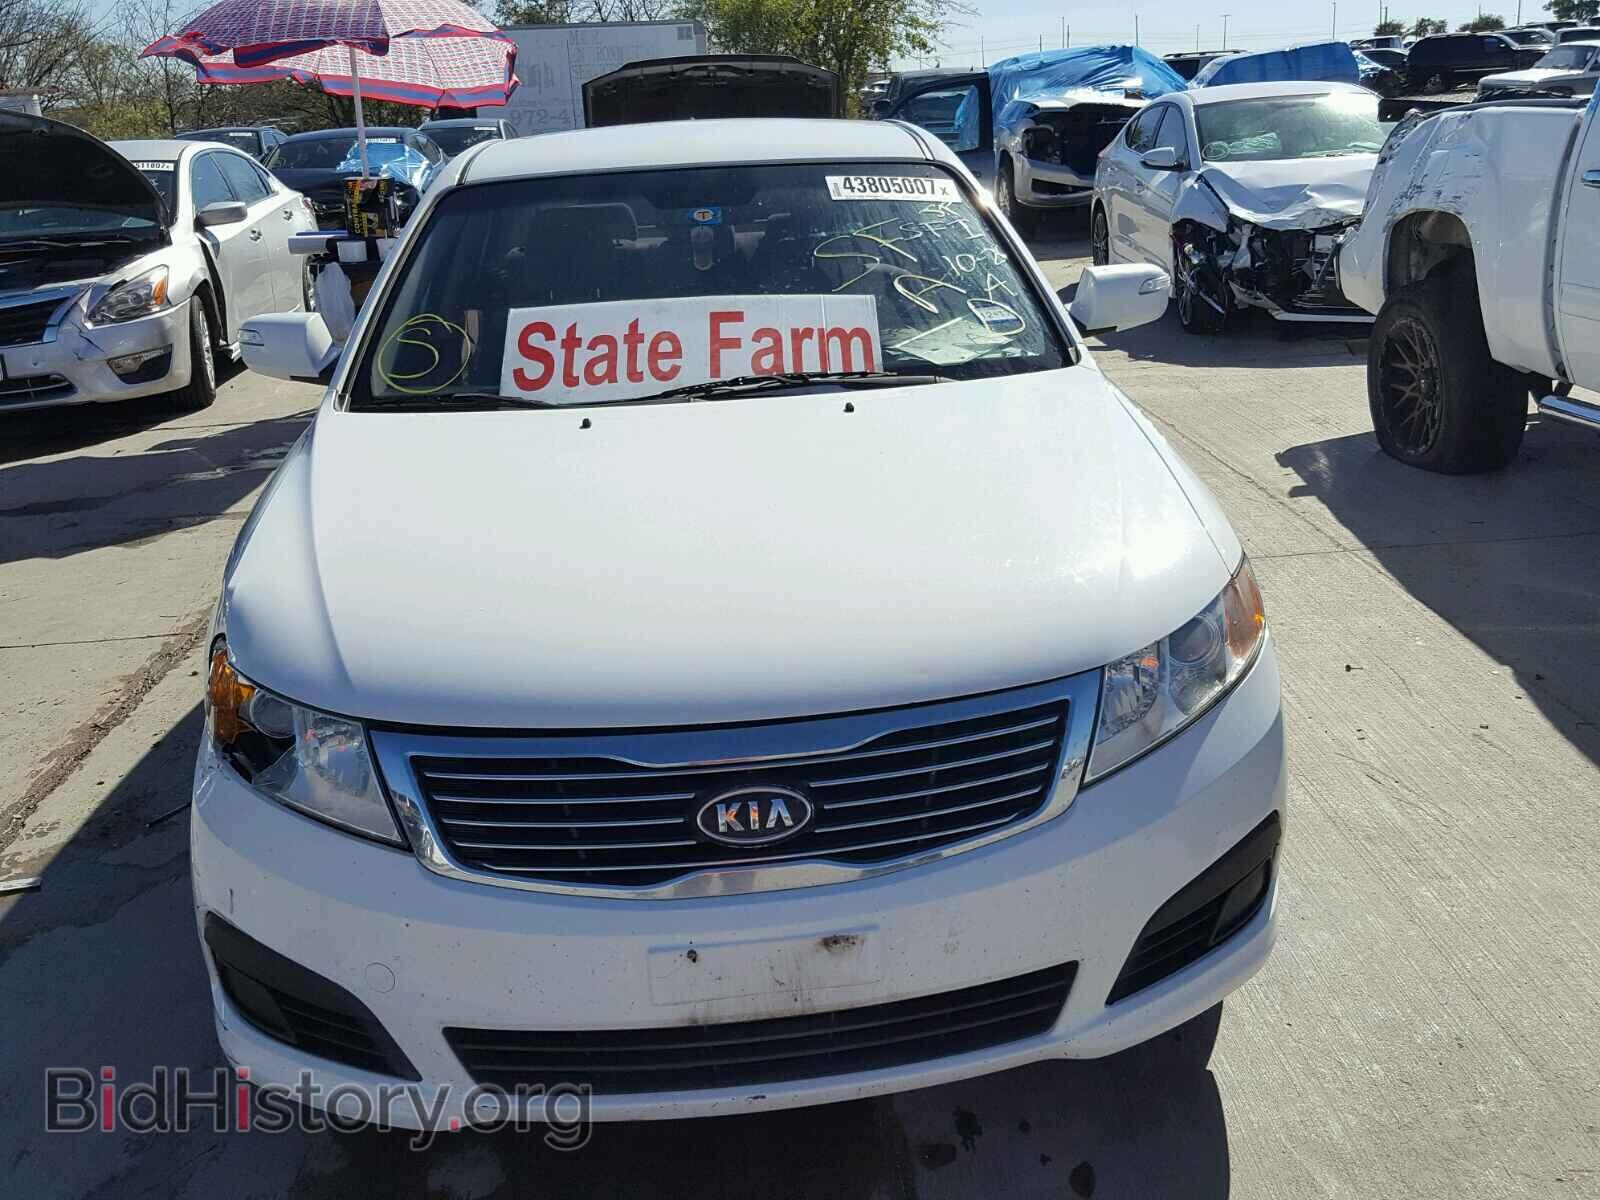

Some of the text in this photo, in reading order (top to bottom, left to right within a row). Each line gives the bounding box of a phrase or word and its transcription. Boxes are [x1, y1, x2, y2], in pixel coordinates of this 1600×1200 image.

[843, 176, 936, 195] 43805007
[513, 311, 875, 392] State Farm
[714, 798, 794, 833] KIA
